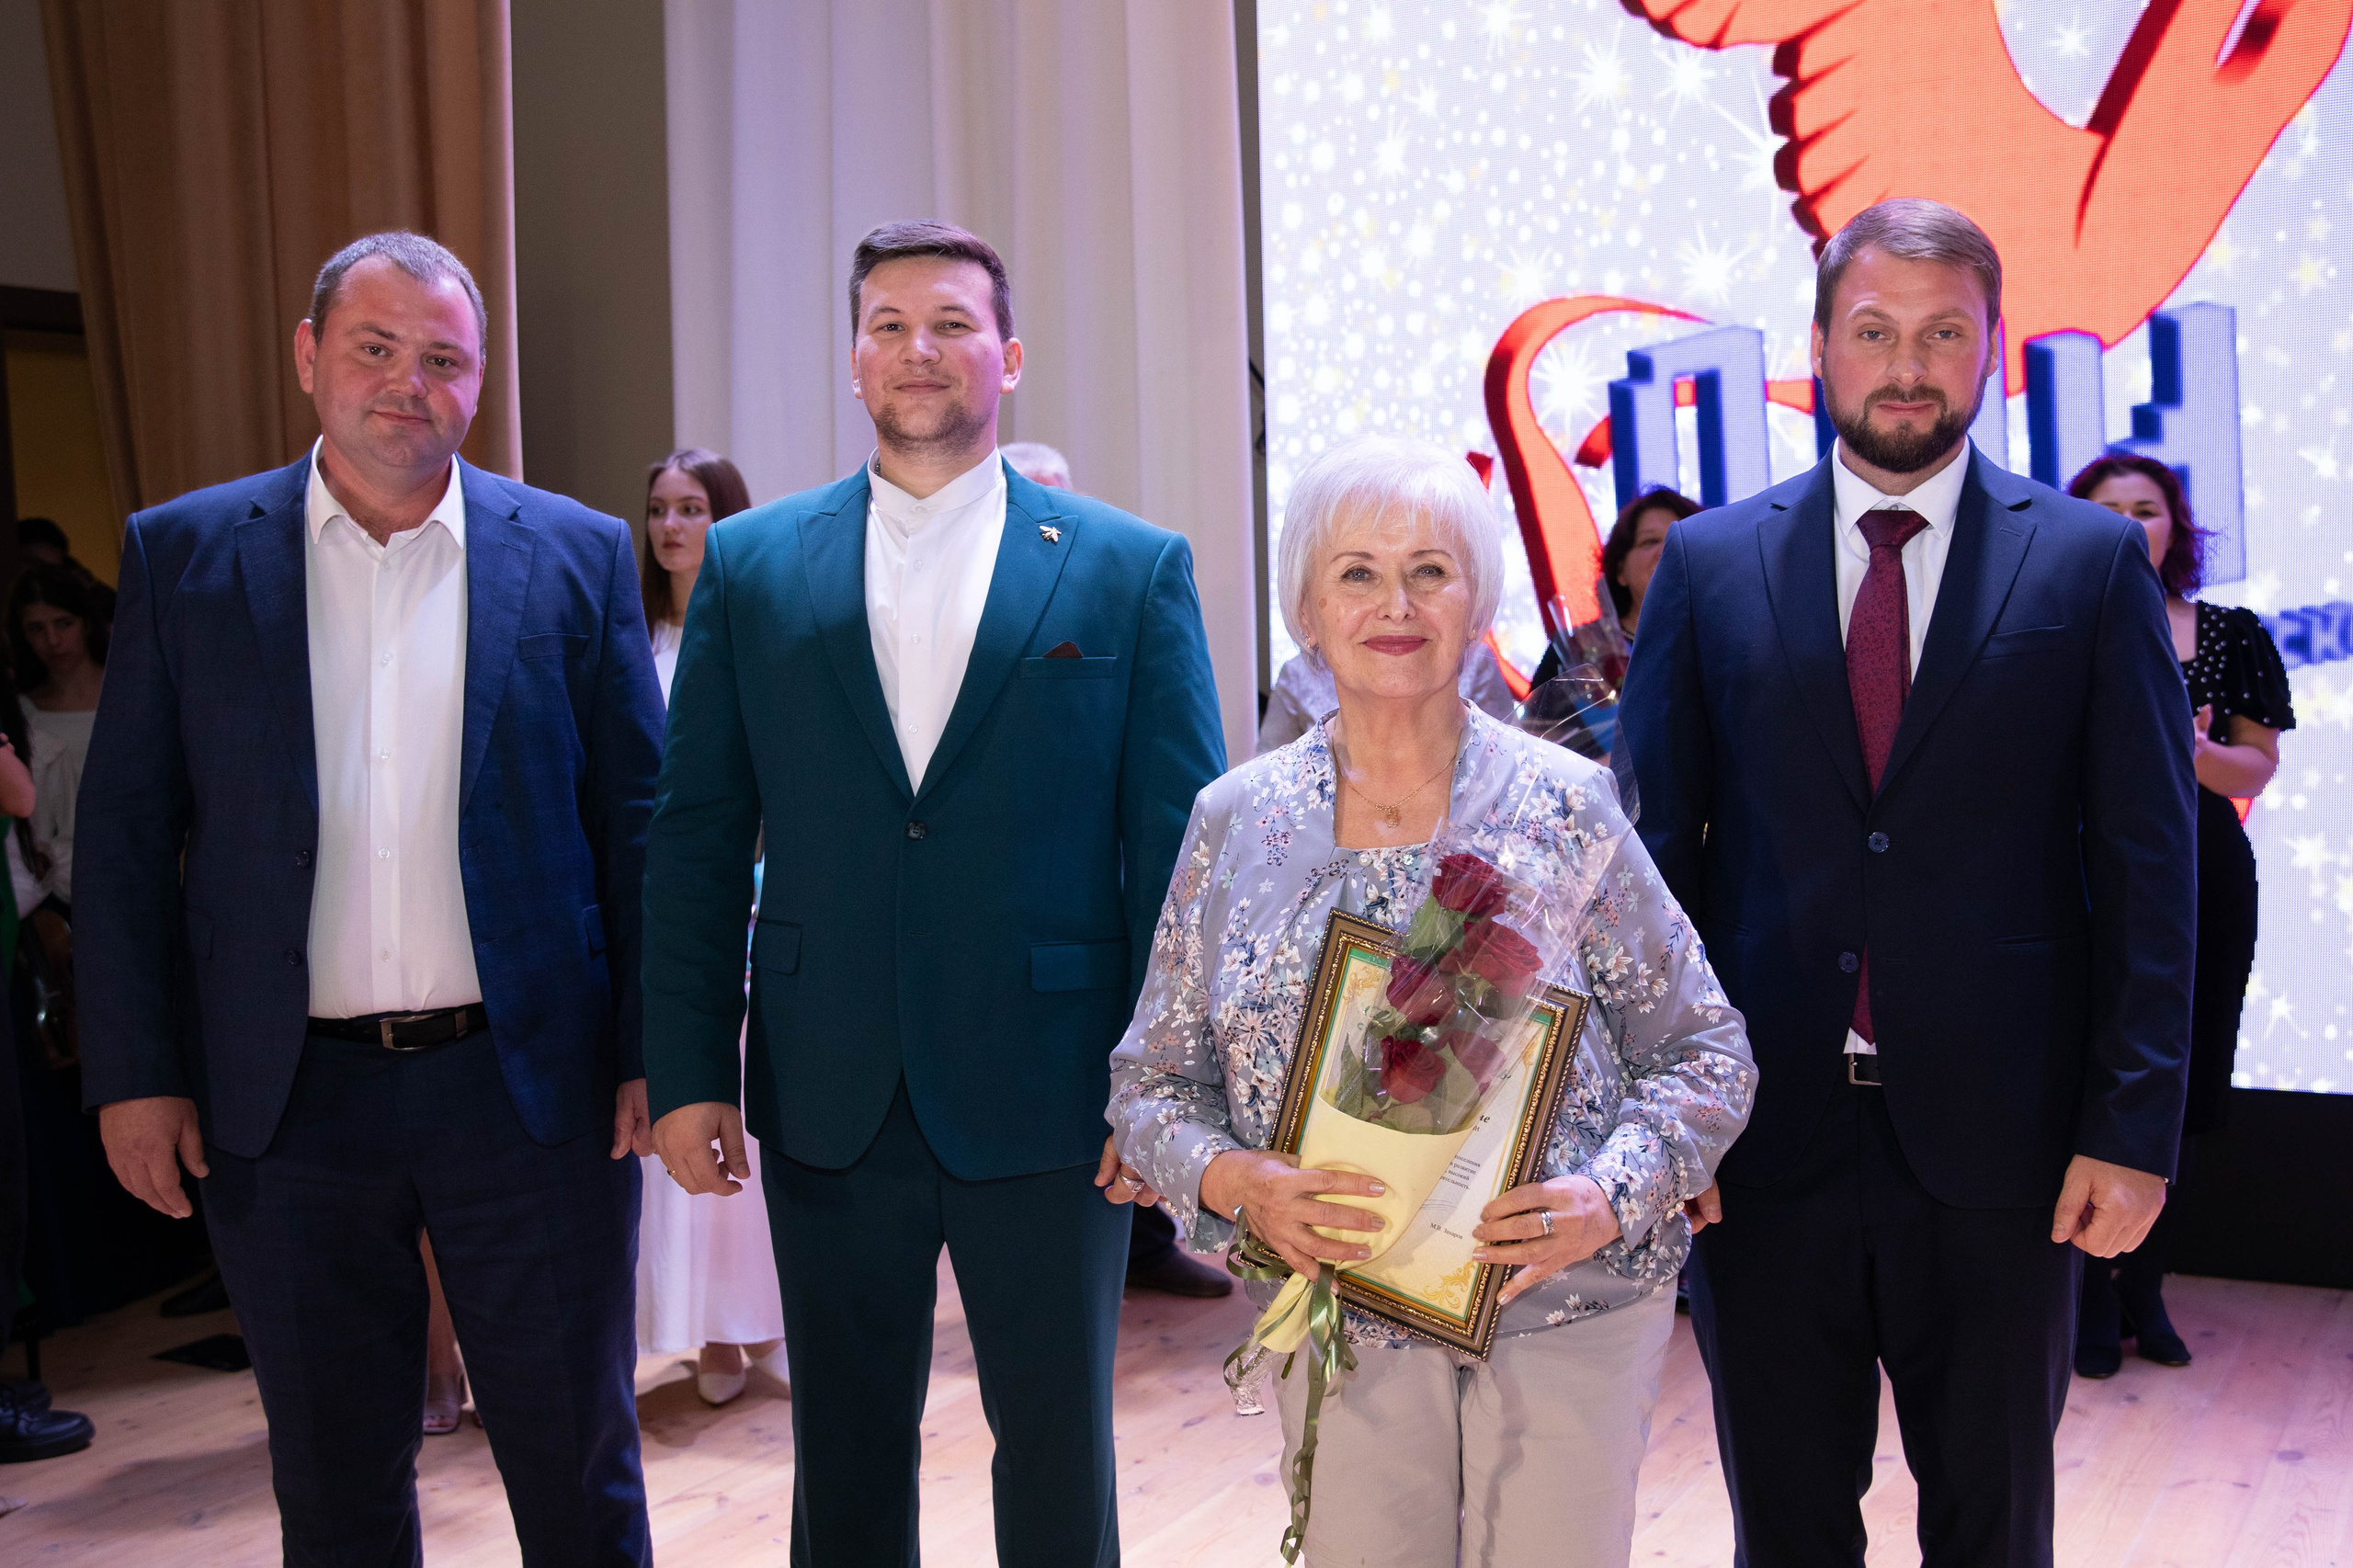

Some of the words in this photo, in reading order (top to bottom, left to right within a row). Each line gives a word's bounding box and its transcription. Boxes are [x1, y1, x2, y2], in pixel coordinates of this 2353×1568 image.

[1448, 1169, 1470, 1181] высокий
[1453, 1163, 1476, 1175] развитие
[1443, 1227, 1463, 1240] Захаров
